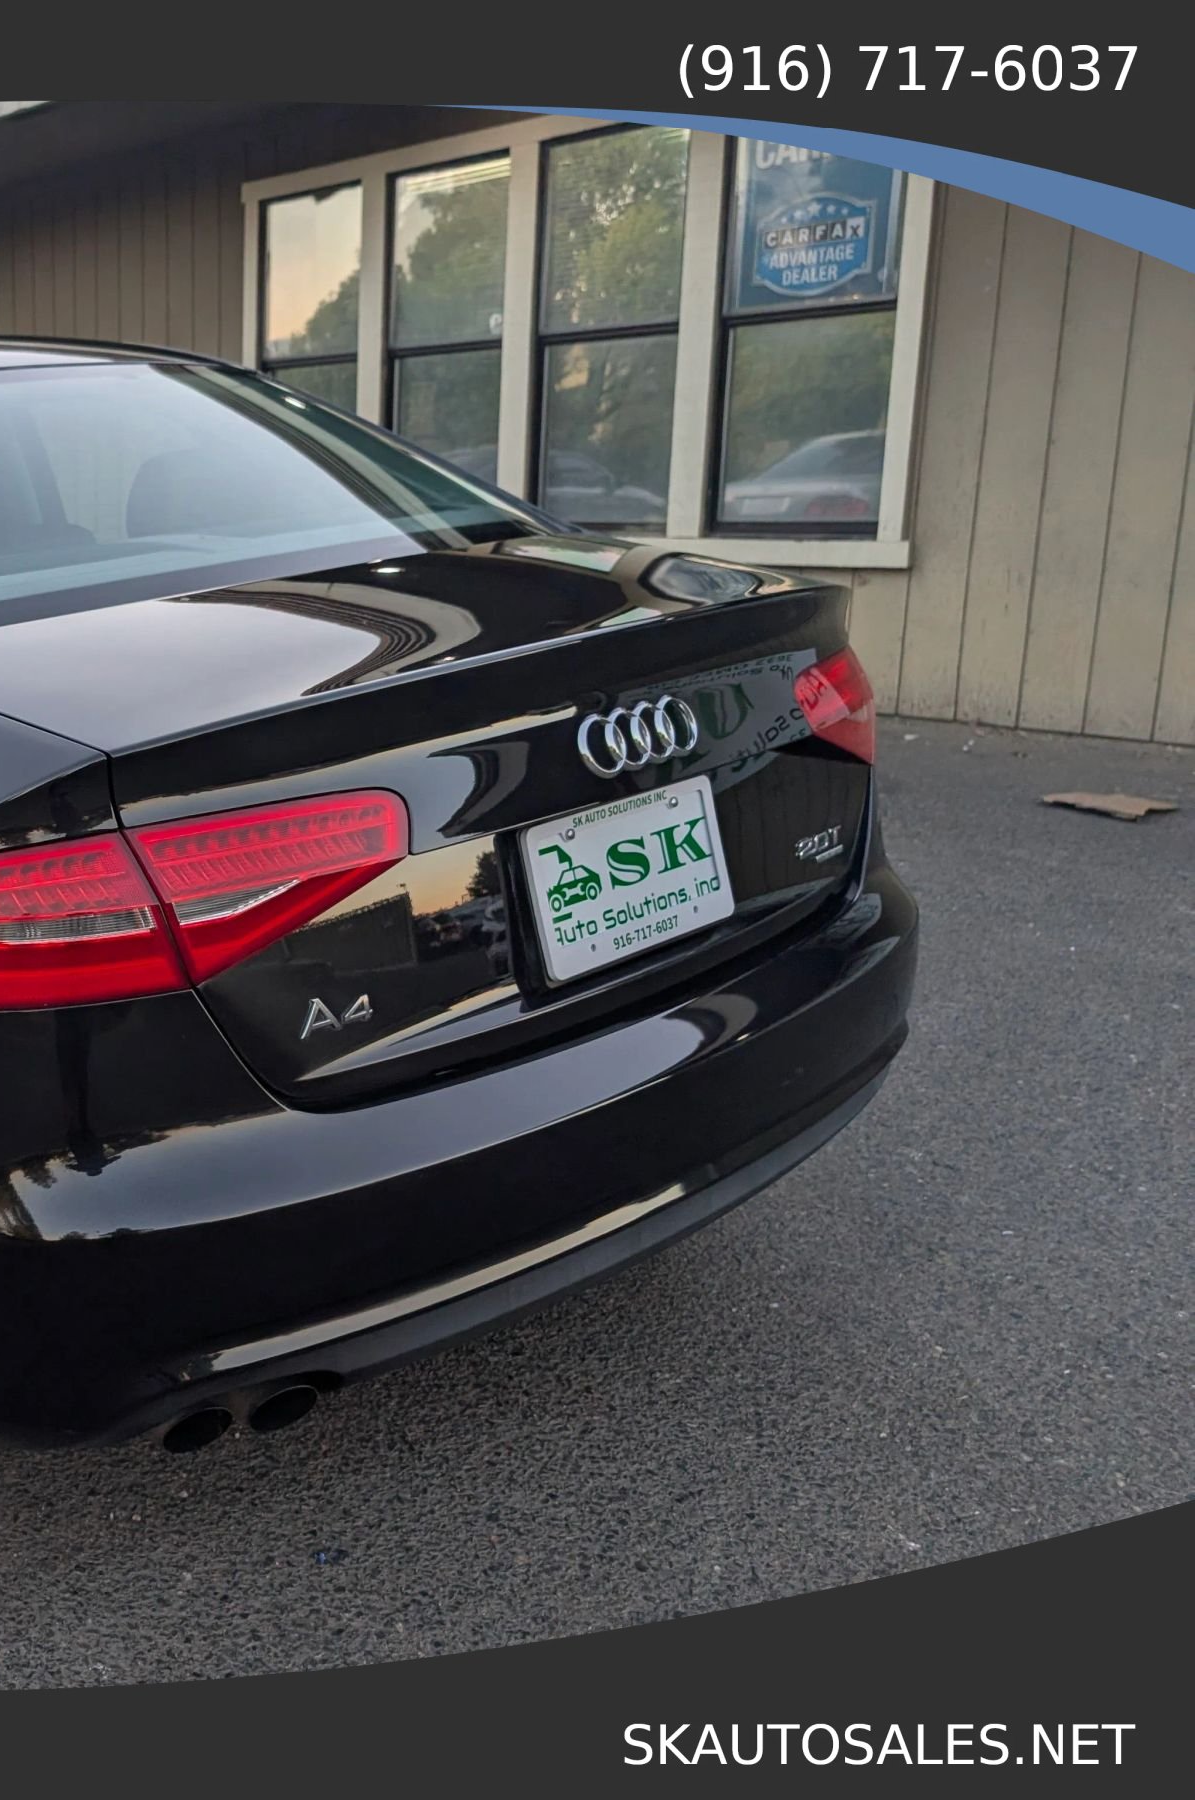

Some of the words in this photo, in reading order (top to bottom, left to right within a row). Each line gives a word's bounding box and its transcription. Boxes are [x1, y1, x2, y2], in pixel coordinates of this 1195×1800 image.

[766, 221, 862, 247] CARFAX
[769, 243, 855, 269] ADVANTAGE
[782, 264, 838, 286] DEALER
[572, 817, 584, 829] SK
[584, 808, 607, 825] AUTO
[607, 794, 653, 816] SOLUTIONS
[653, 790, 668, 803] INC
[606, 816, 713, 890] SK
[603, 887, 692, 930] Solutions,
[613, 914, 679, 950] 916-717-6037
[300, 993, 373, 1039] A4
